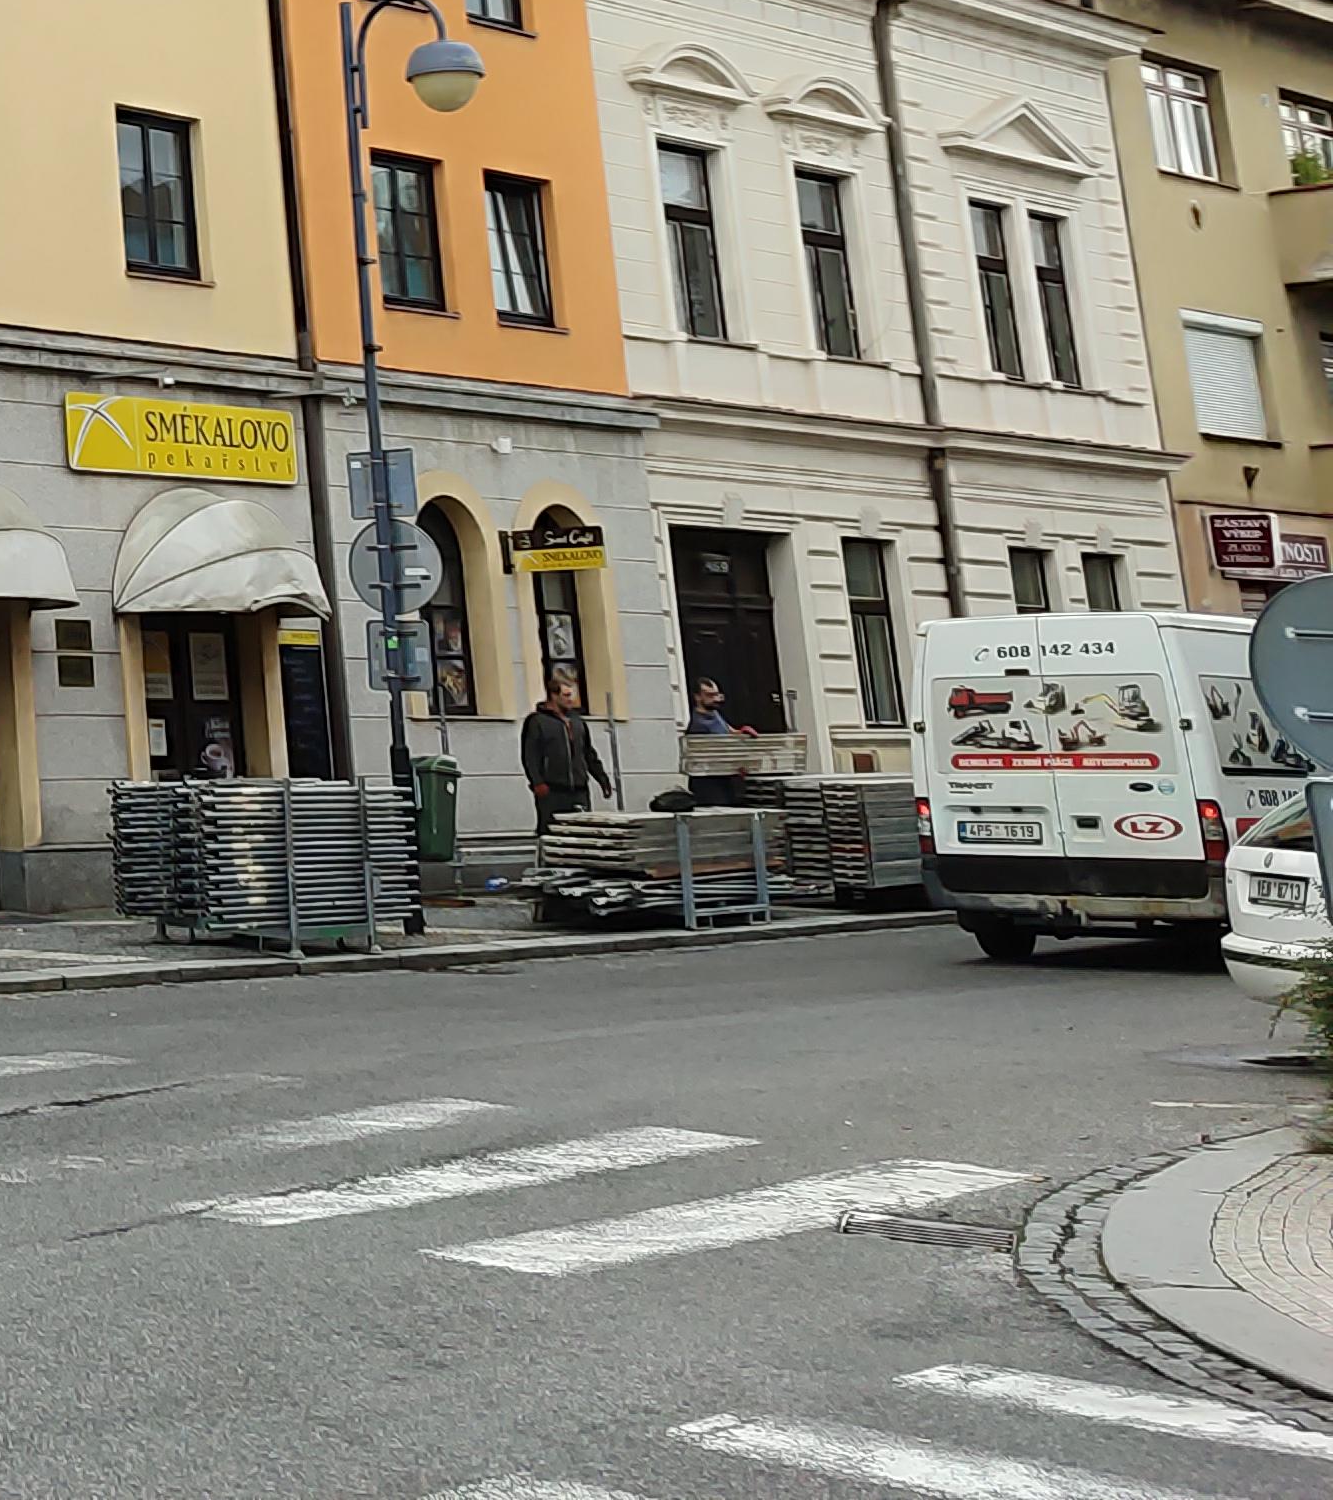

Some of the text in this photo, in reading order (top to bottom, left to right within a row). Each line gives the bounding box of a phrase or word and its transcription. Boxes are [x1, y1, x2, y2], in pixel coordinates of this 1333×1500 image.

[996, 641, 1116, 659] 608 142 434
[1258, 789, 1280, 807] 608
[969, 824, 1034, 838] 4P5 1619
[1129, 821, 1165, 835] LZ
